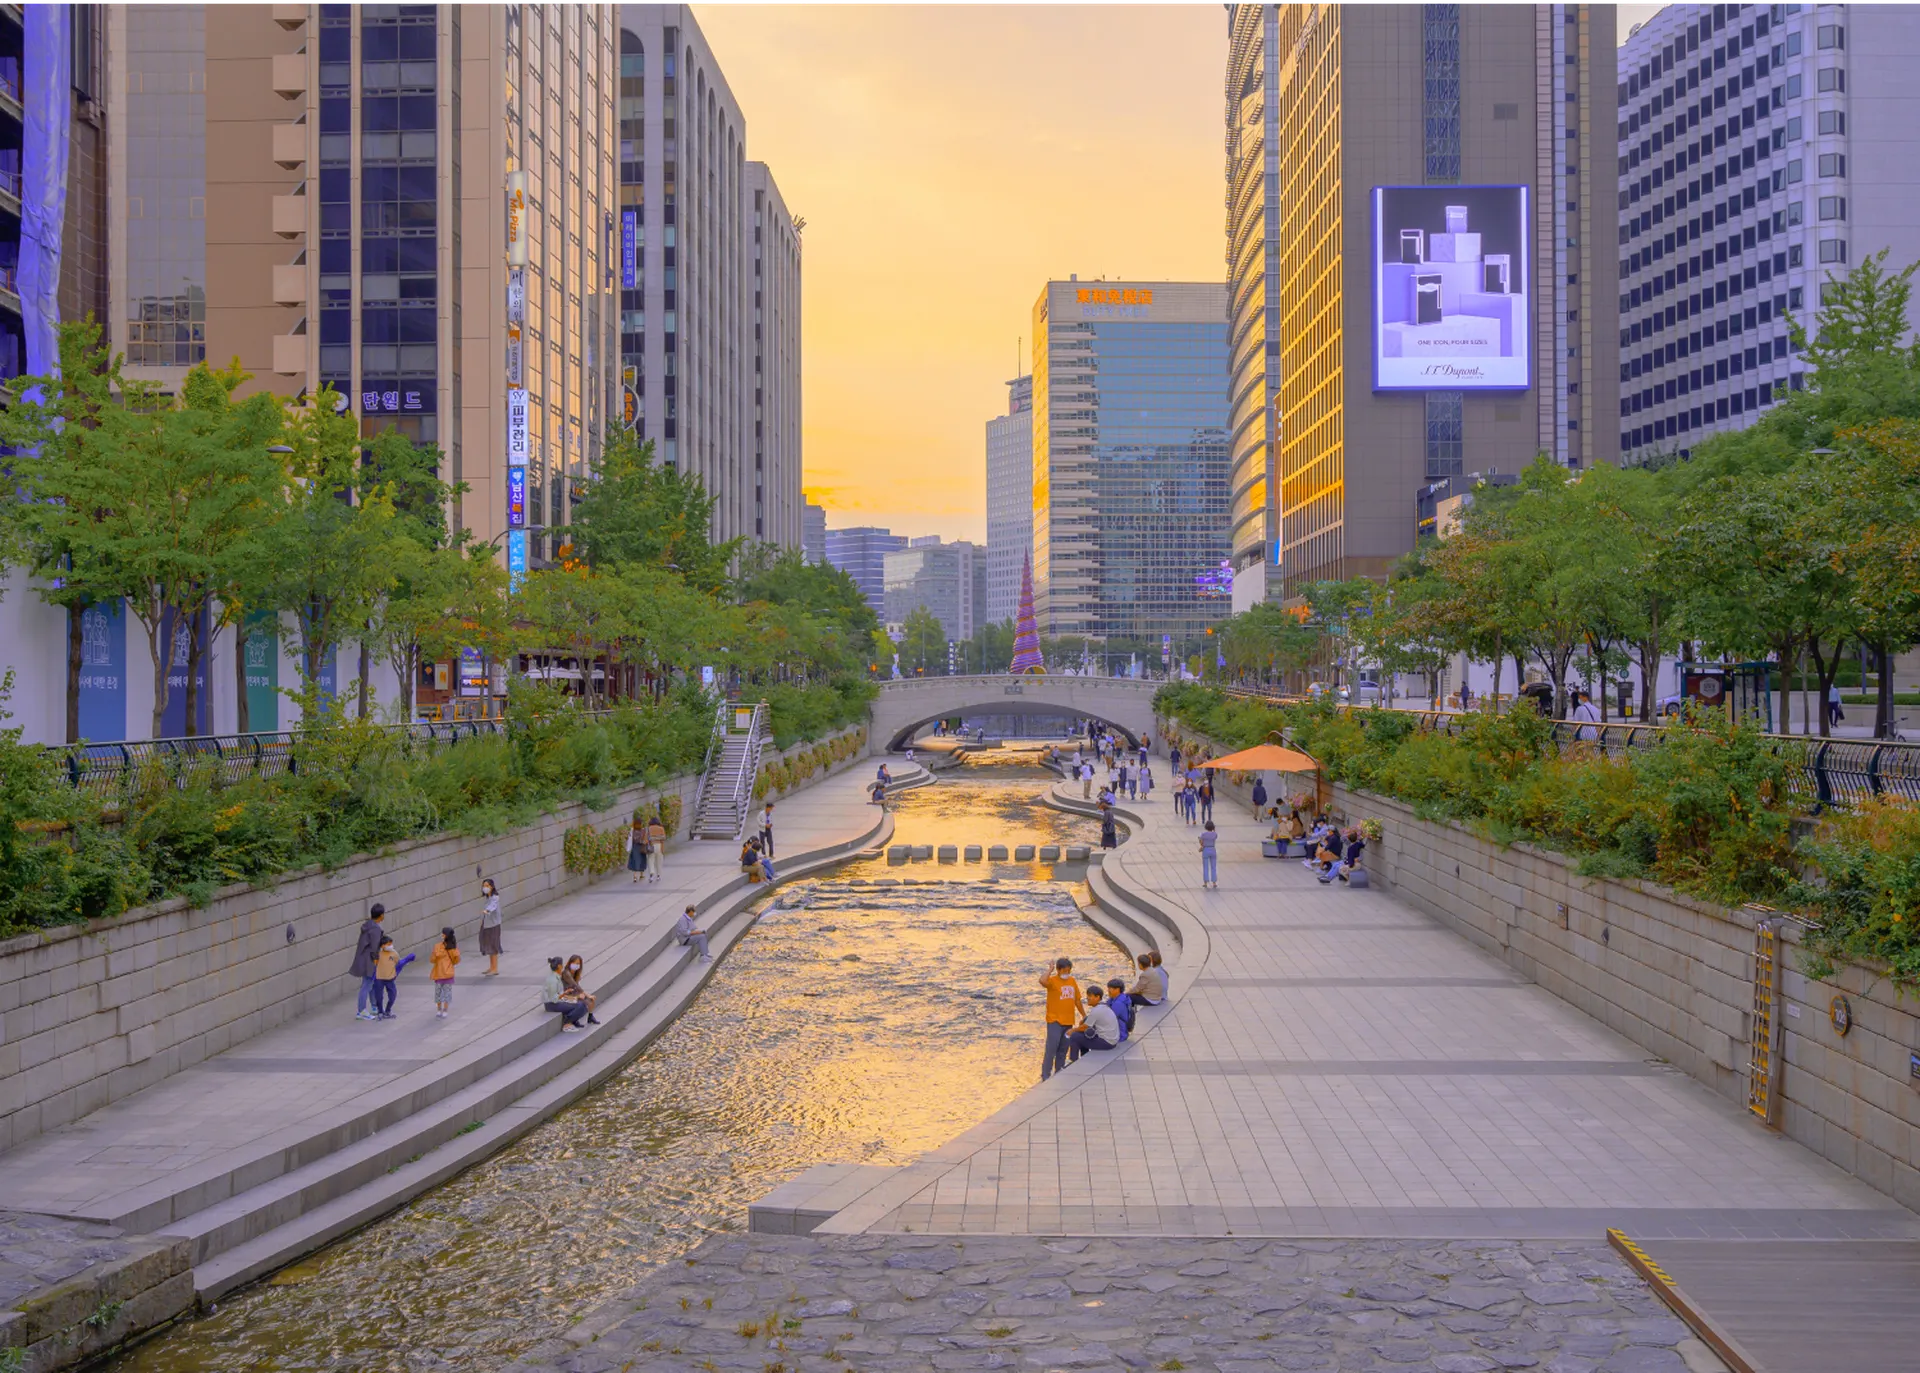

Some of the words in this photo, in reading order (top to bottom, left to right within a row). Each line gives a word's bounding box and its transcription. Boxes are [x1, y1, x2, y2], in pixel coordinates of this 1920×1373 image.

[1083, 305, 1114, 317] DUTY
[1119, 306, 1148, 317] FREE
[1442, 364, 1484, 379] Dupont
[624, 392, 633, 422] BAR
[512, 405, 525, 453] 피부관리
